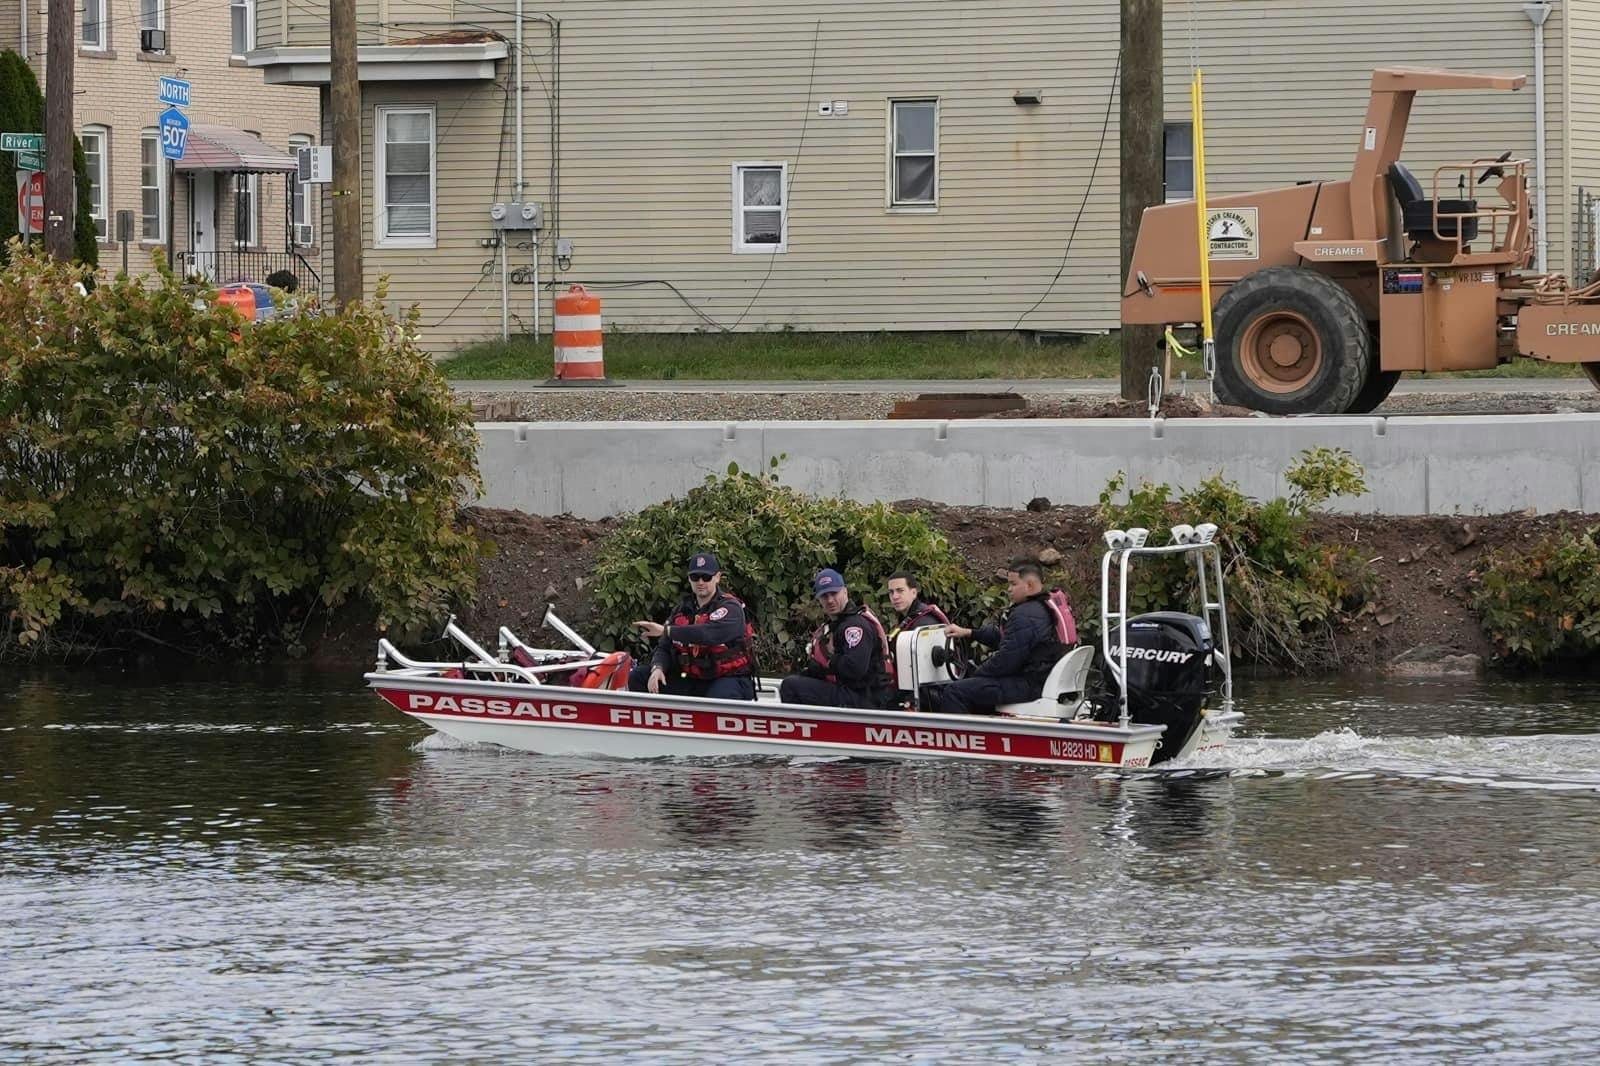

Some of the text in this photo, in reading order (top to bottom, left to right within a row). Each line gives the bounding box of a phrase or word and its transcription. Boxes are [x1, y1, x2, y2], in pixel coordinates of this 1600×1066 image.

[160, 80, 189, 101] NORTH
[5, 136, 32, 148] River
[163, 125, 187, 148] 507
[1314, 247, 1364, 256] CREAMER
[1546, 323, 1600, 336] CREAM
[1109, 645, 1194, 664] MERCURY
[408, 694, 1012, 753] PASSAIC FIRE DEPT MARINE 1
[1050, 740, 1061, 756] NJ
[1062, 741, 1083, 759] 2823
[1084, 743, 1097, 760] HD
